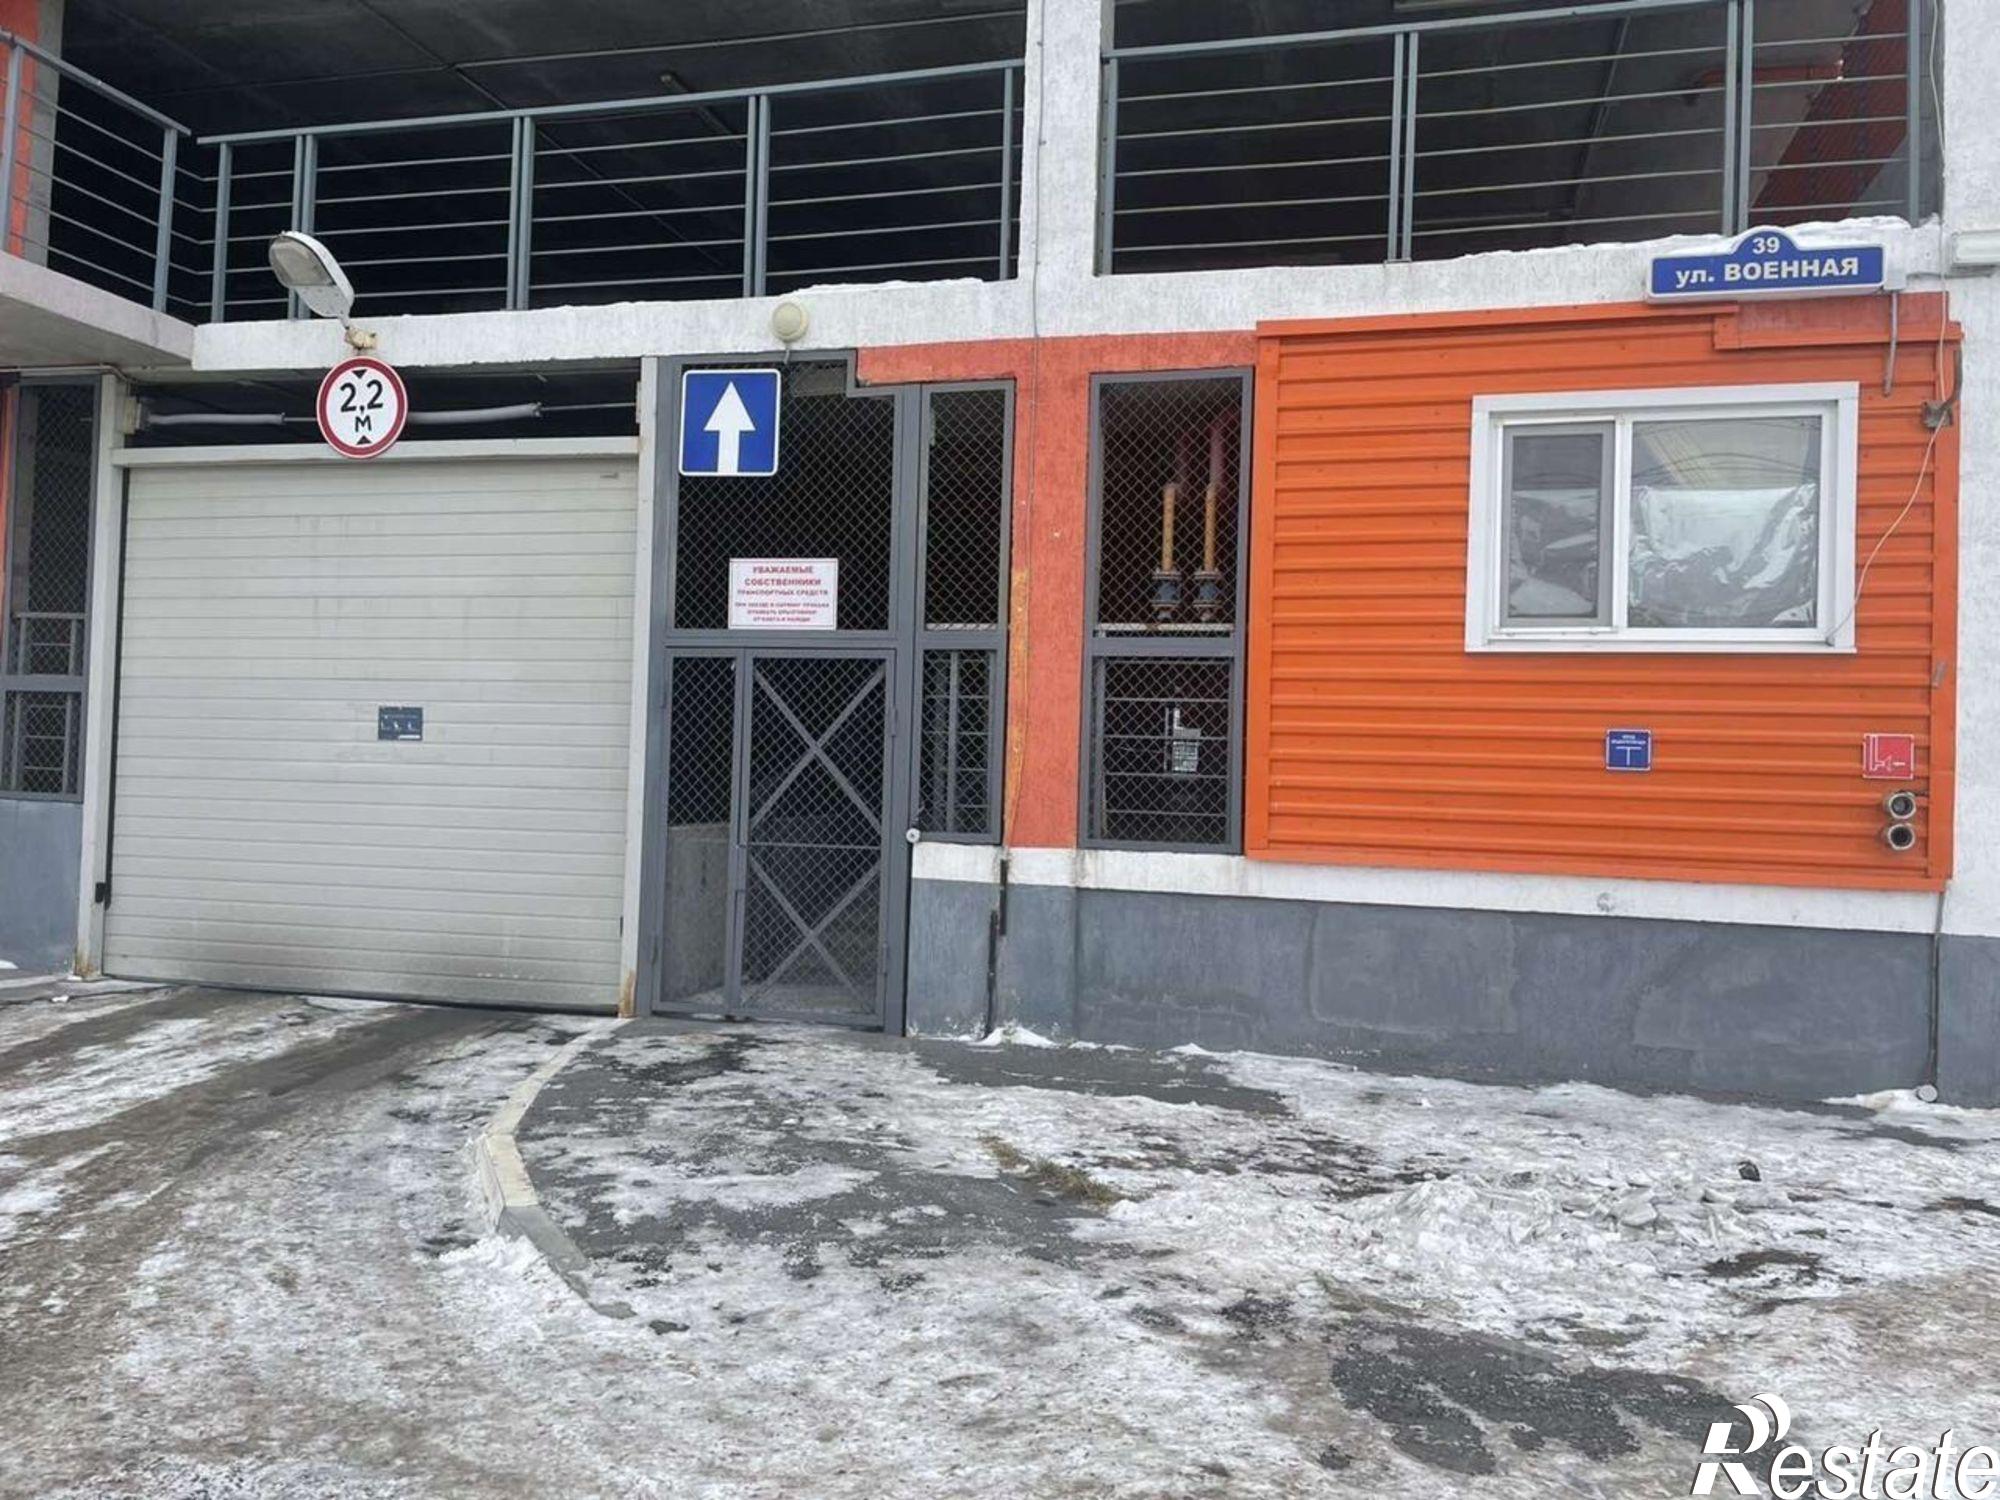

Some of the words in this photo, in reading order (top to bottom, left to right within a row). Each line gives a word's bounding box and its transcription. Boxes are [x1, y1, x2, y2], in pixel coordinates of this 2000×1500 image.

[1752, 236, 1780, 255] 39
[1676, 269, 1715, 289] ул.
[1724, 257, 1859, 282] ВОЕННАЯ
[340, 380, 383, 414] 2,2
[752, 566, 814, 574] УВАЖАЕМЫЕ
